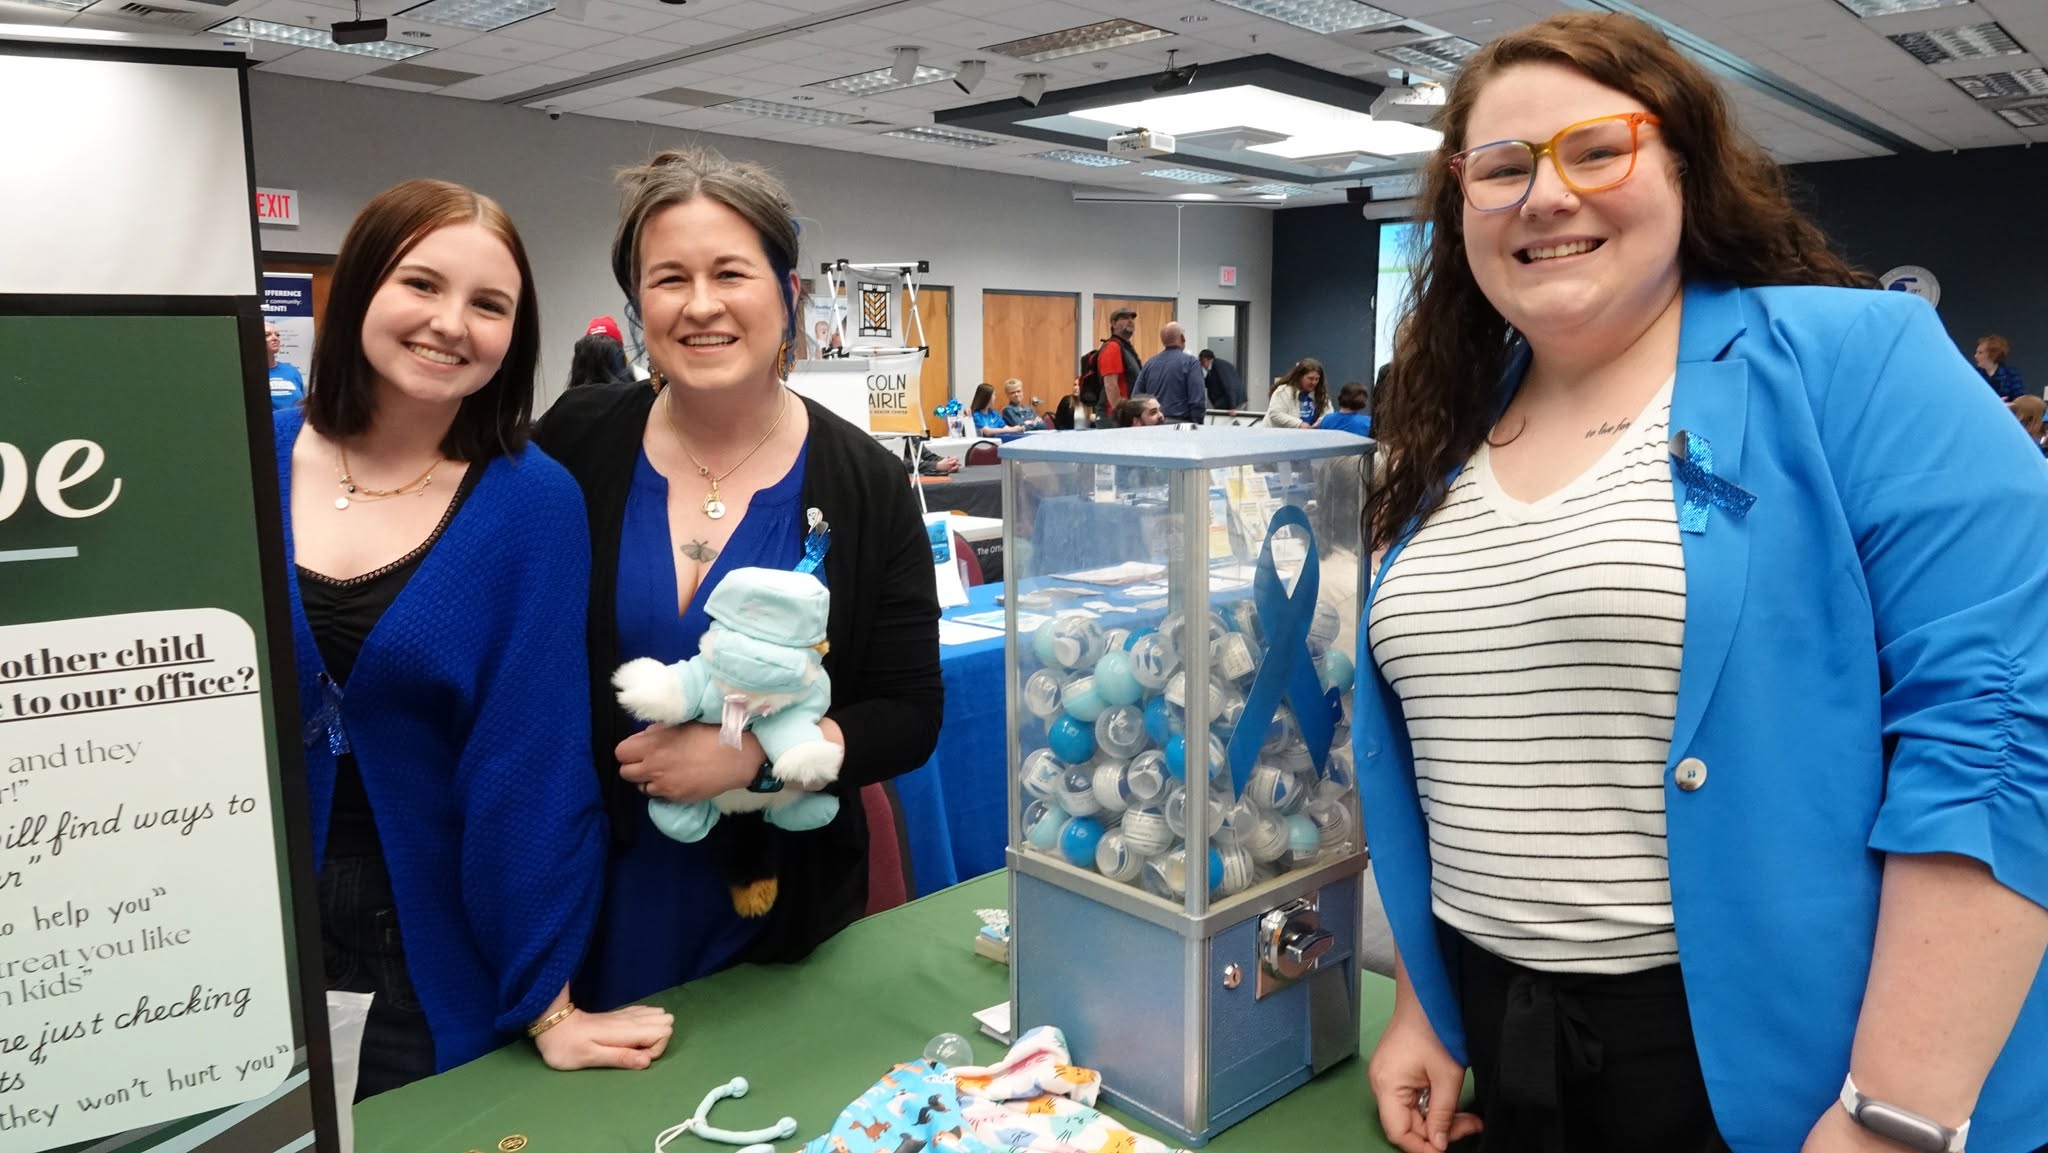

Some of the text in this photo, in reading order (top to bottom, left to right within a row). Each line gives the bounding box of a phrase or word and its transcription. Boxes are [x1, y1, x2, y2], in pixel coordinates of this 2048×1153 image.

[256, 193, 290, 218] EXIT
[0, 633, 206, 679] other child
[12, 692, 51, 717] to
[60, 684, 126, 711] our
[134, 666, 255, 702] office?
[8, 739, 143, 774] and they
[0, 794, 257, 856] ill find ways to
[33, 901, 90, 931] help
[77, 939, 136, 970] you
[142, 925, 193, 952] like
[29, 1012, 104, 1062] just
[114, 984, 253, 1030] checking
[0, 1104, 60, 1132] they
[167, 1064, 223, 1092] hurt
